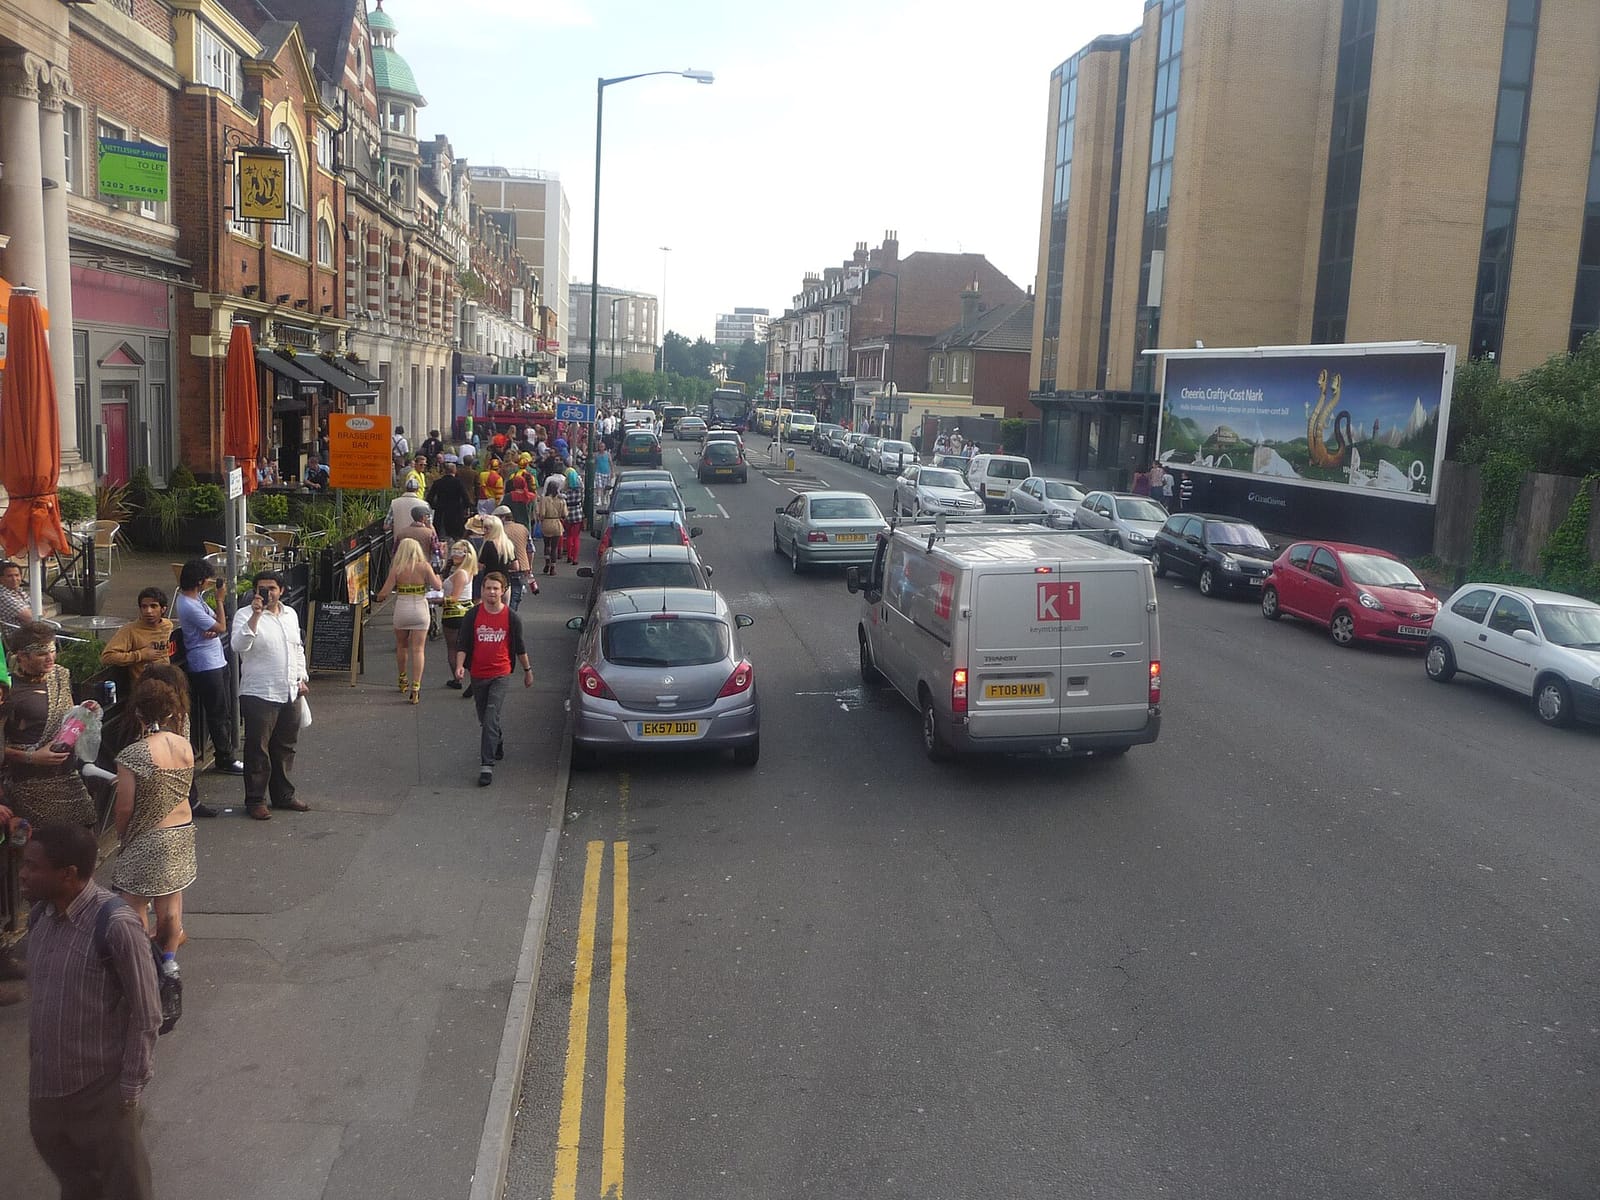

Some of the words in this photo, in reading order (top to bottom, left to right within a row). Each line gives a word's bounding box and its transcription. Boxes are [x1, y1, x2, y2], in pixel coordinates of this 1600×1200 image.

[137, 161, 149, 169] TO
[151, 163, 164, 171] LET
[1206, 388, 1245, 403] Crafty-Cost
[337, 432, 384, 440] BRASSERIE
[352, 441, 369, 449] BAR
[478, 633, 502, 642] CREW
[991, 685, 1018, 696] FT08
[644, 724, 672, 734] EK57
